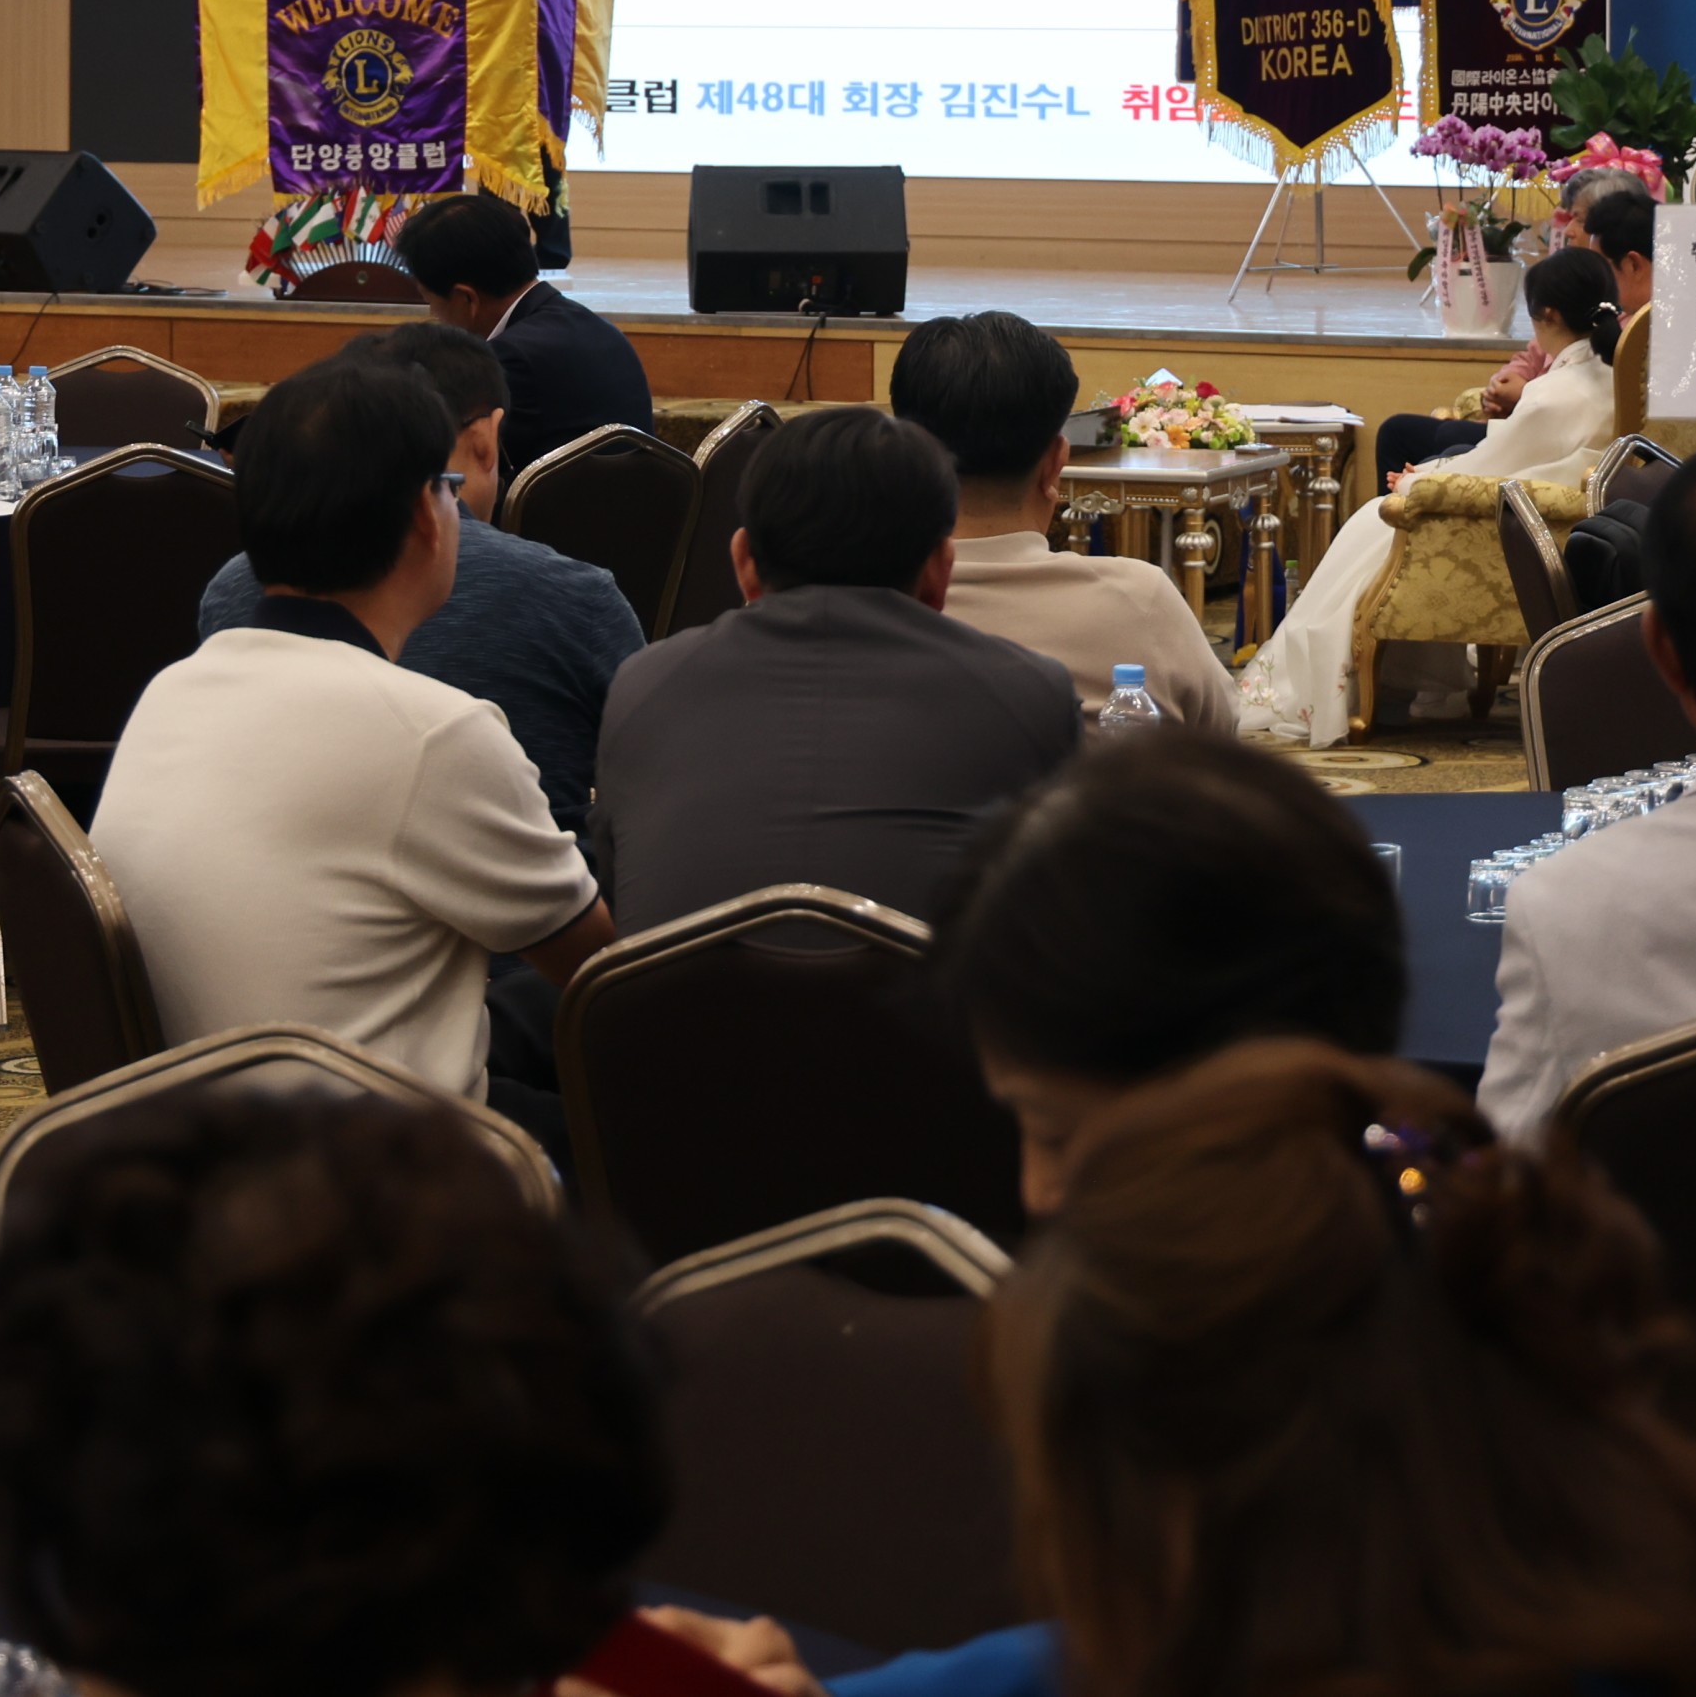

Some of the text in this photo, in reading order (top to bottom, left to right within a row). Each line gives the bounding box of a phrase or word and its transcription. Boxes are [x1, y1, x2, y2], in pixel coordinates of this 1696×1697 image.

[338, 30, 392, 53] LIONS
[354, 59, 379, 94] L
[1261, 43, 1353, 81] KOREA
[695, 78, 826, 117] 제48대
[842, 79, 922, 119] 회장
[939, 81, 1090, 121] 김진수L
[1122, 84, 1203, 122] 취임
[290, 141, 447, 171] 단양중앙클럽
